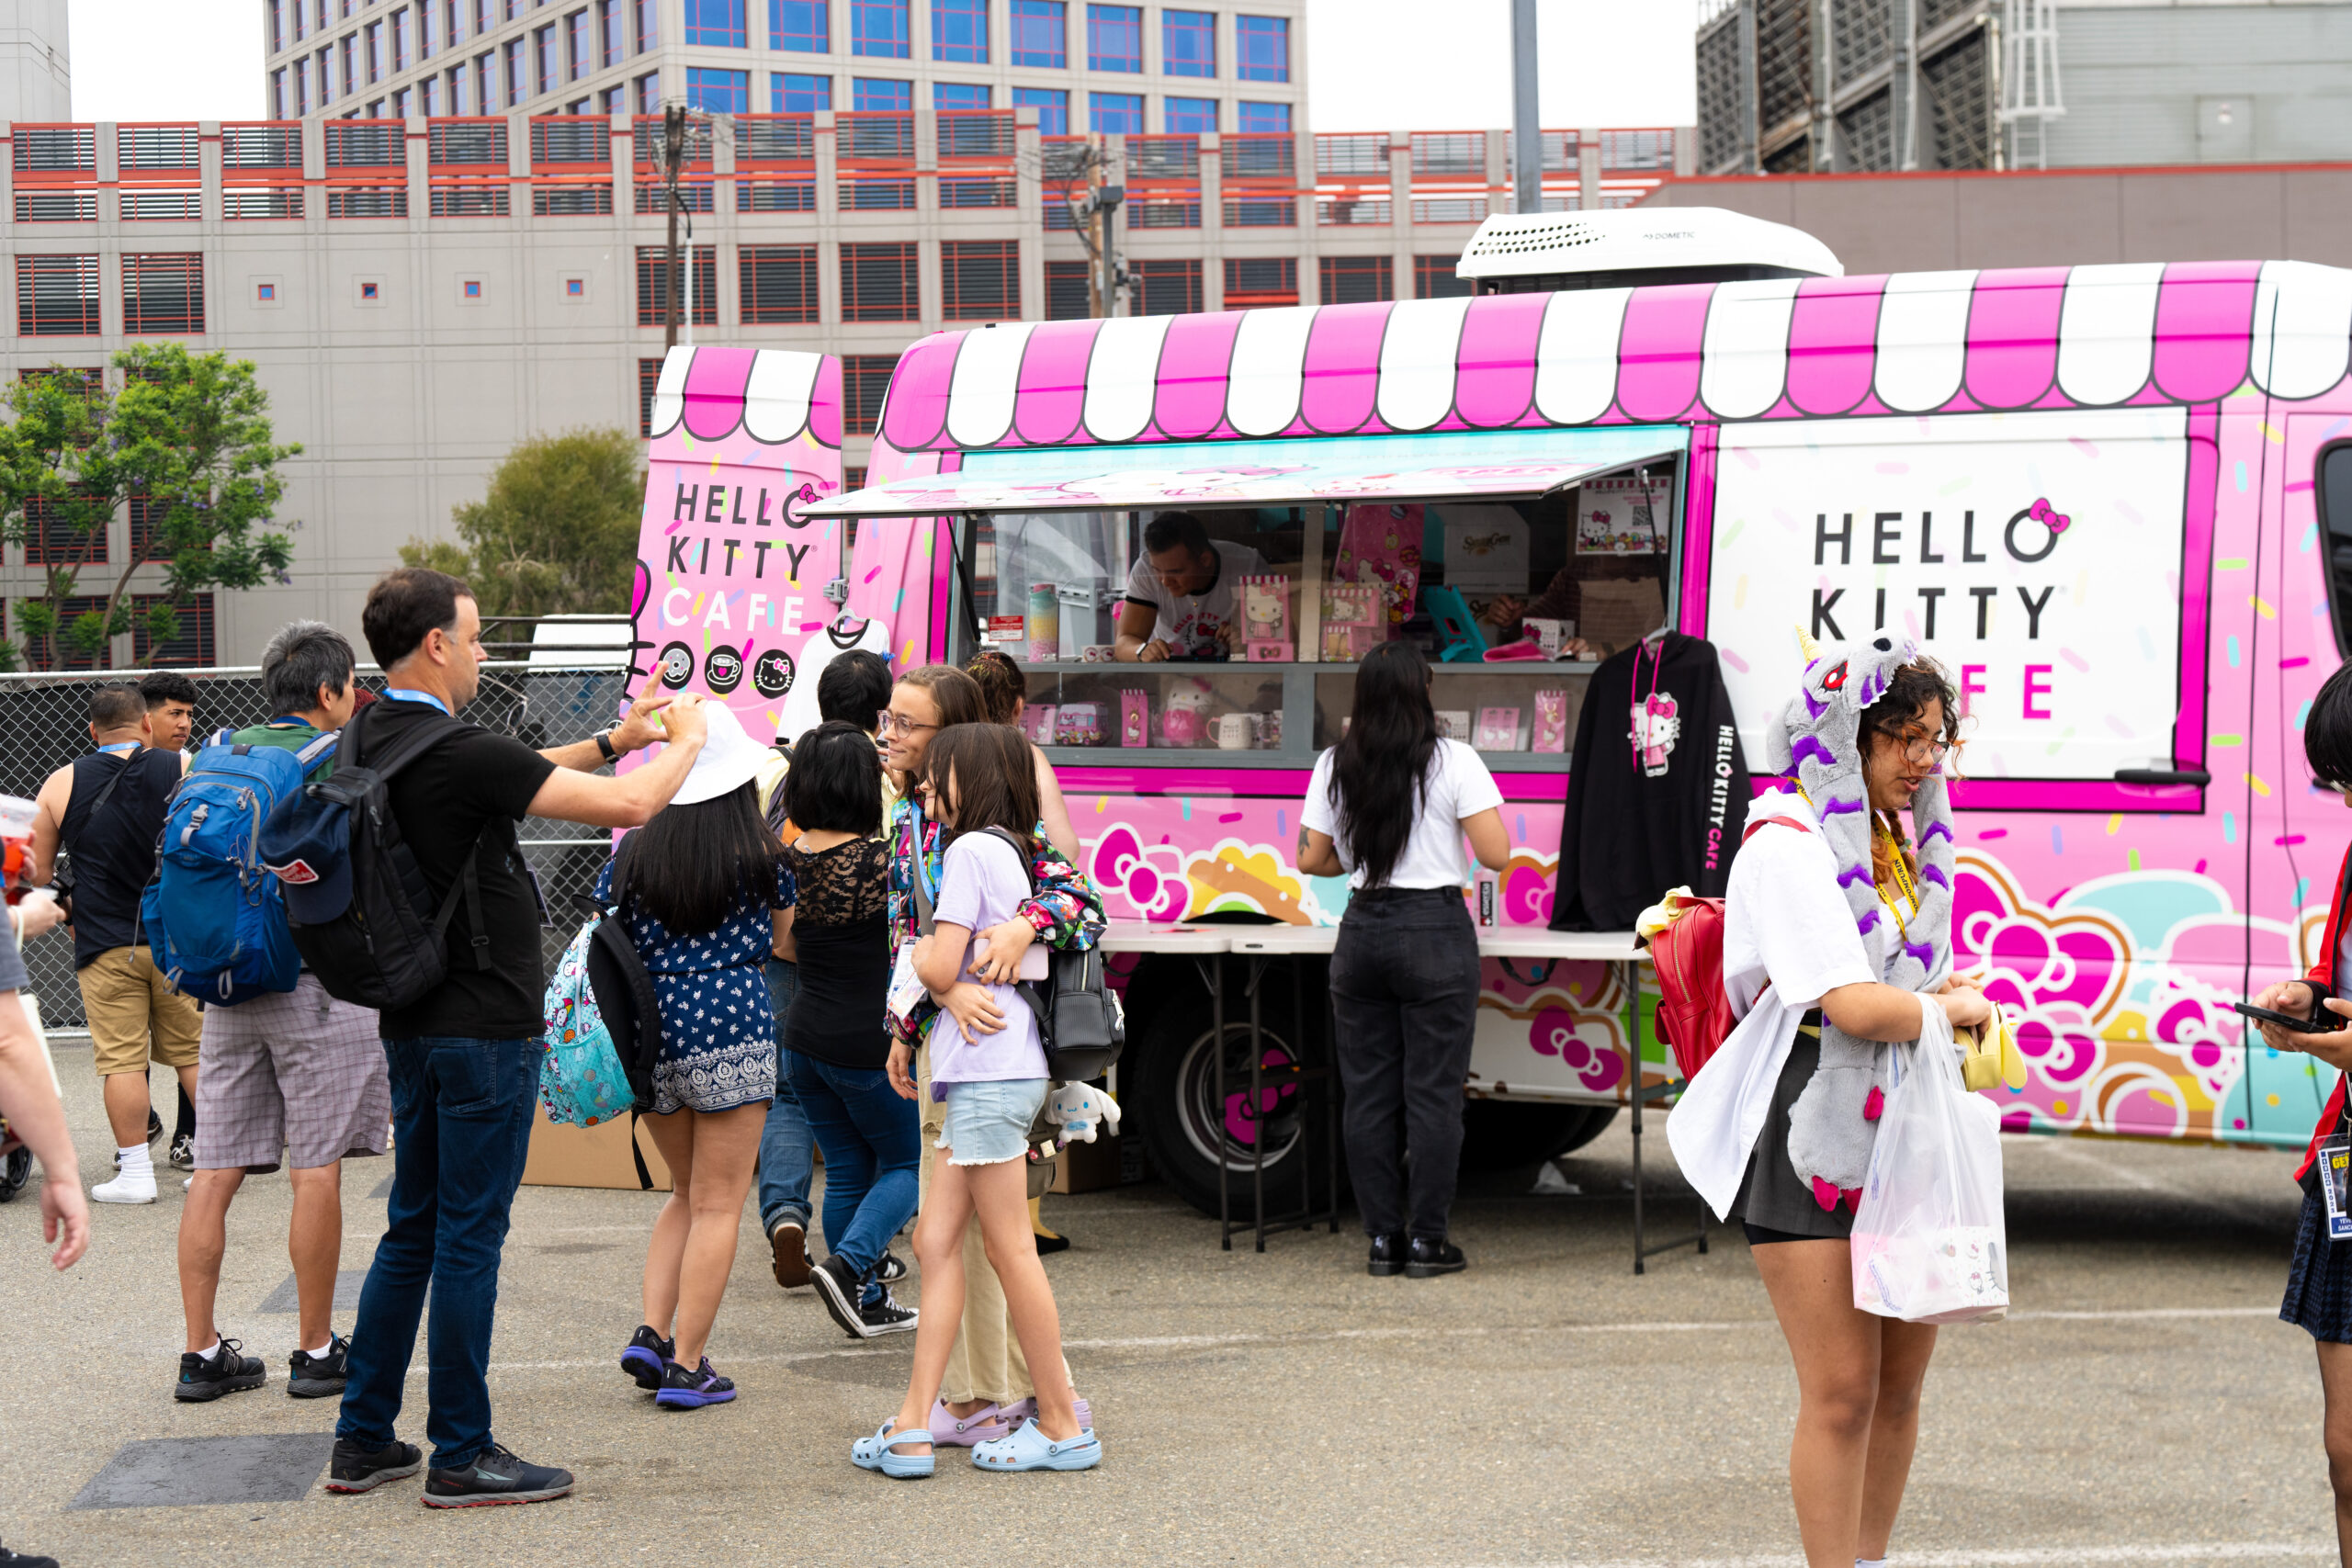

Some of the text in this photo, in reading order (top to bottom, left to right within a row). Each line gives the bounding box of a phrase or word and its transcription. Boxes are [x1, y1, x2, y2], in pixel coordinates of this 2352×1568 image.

[1655, 231, 1695, 240] DOMETIC
[673, 483, 812, 530] HELLO
[667, 536, 810, 581] KITTY
[1815, 508, 2058, 565] HELLO
[662, 588, 805, 636] CAFE
[1811, 585, 2055, 641] KITTY
[1960, 664, 2053, 719] FE
[1705, 725, 1734, 870] HELLO KITTY CAFE
